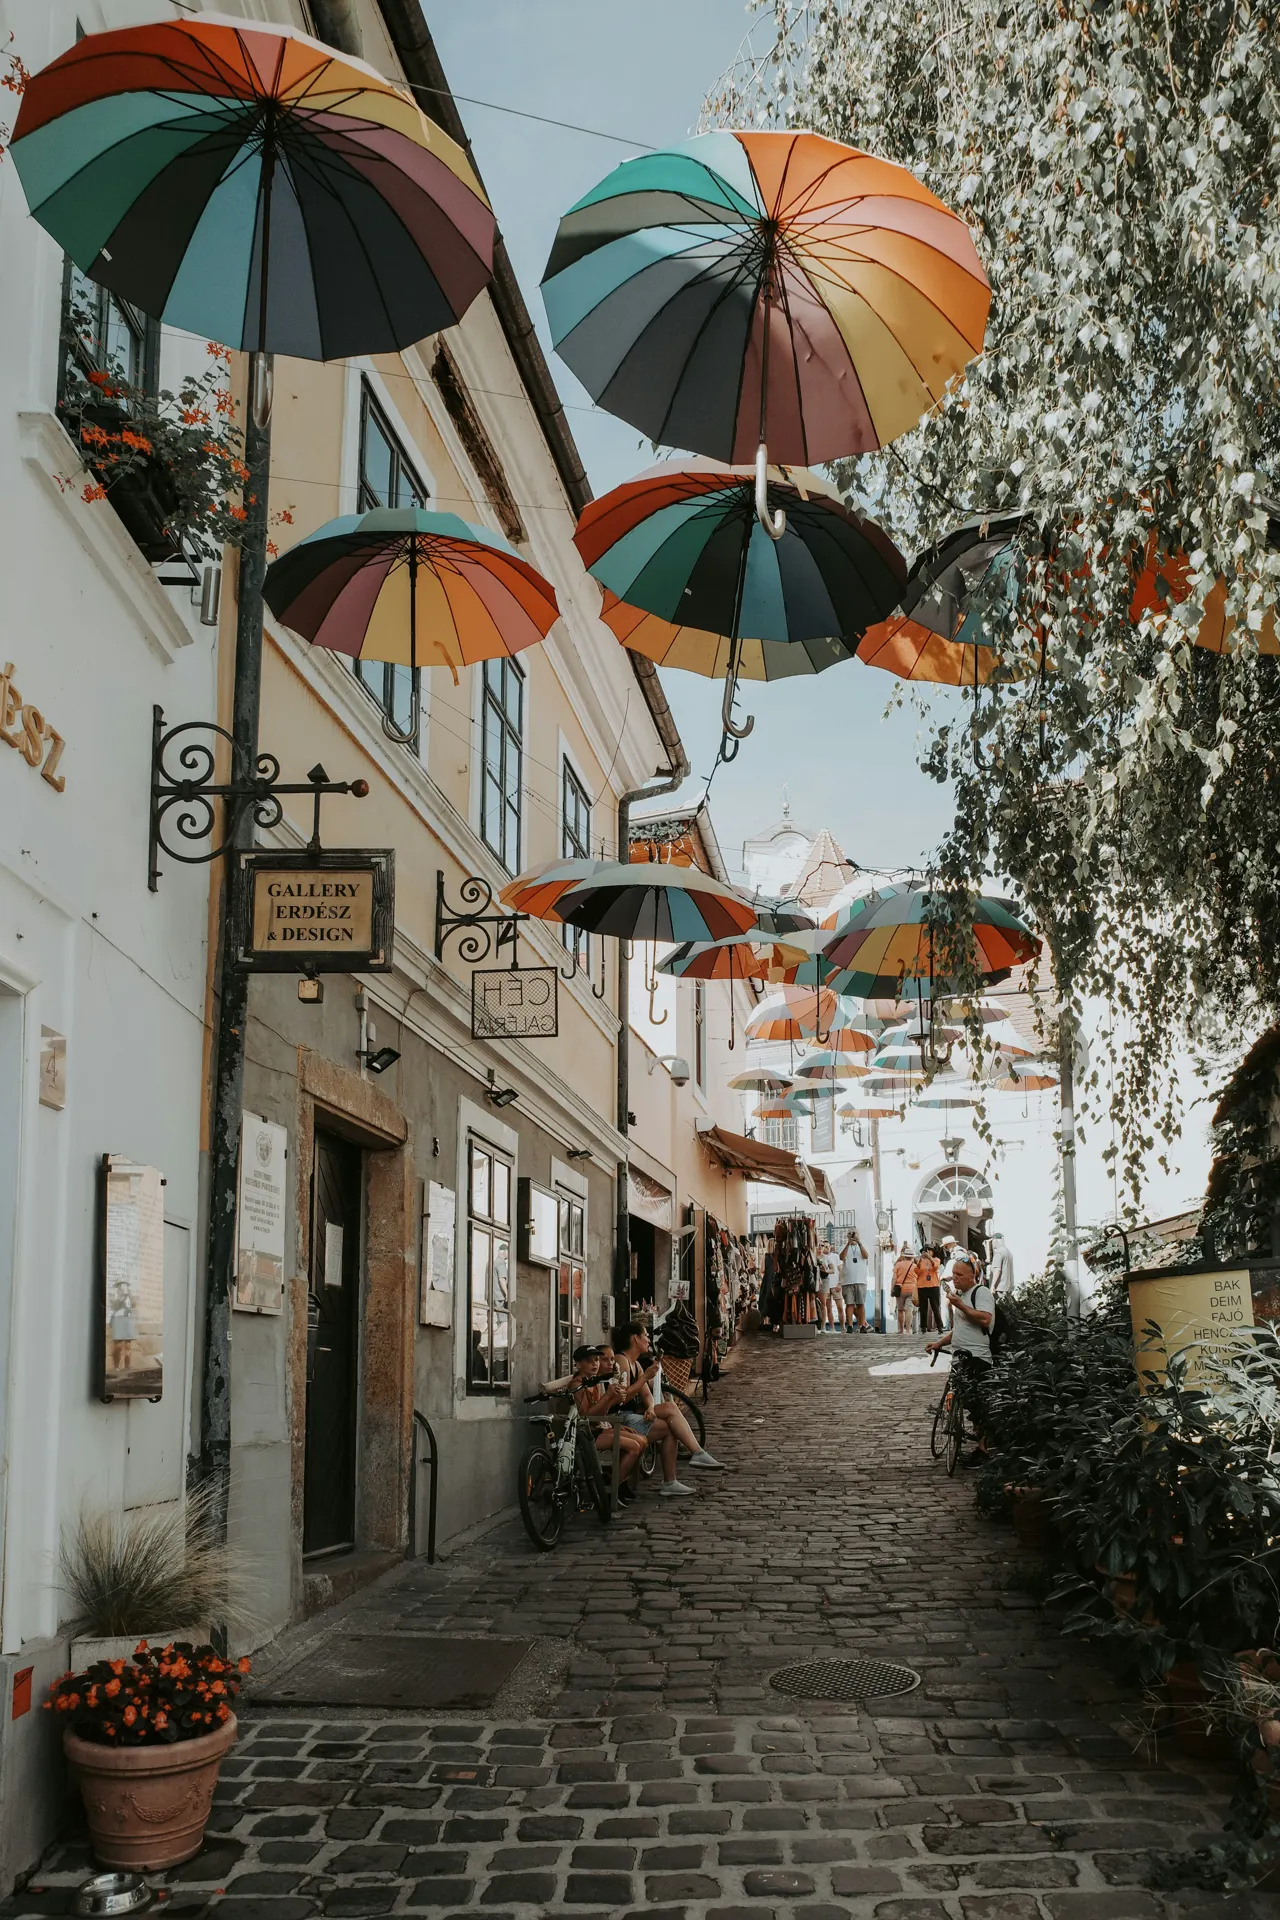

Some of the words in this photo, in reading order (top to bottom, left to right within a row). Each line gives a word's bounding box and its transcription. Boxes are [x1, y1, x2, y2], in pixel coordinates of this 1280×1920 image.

[267, 883, 360, 897] GALLERY
[276, 902, 352, 919] ERDÉSZ
[267, 931, 277, 941] &
[282, 927, 354, 941] DESIGN
[1214, 1279, 1241, 1292] BAK
[1210, 1295, 1242, 1308] DEIM
[1211, 1308, 1244, 1323] FAJÓ
